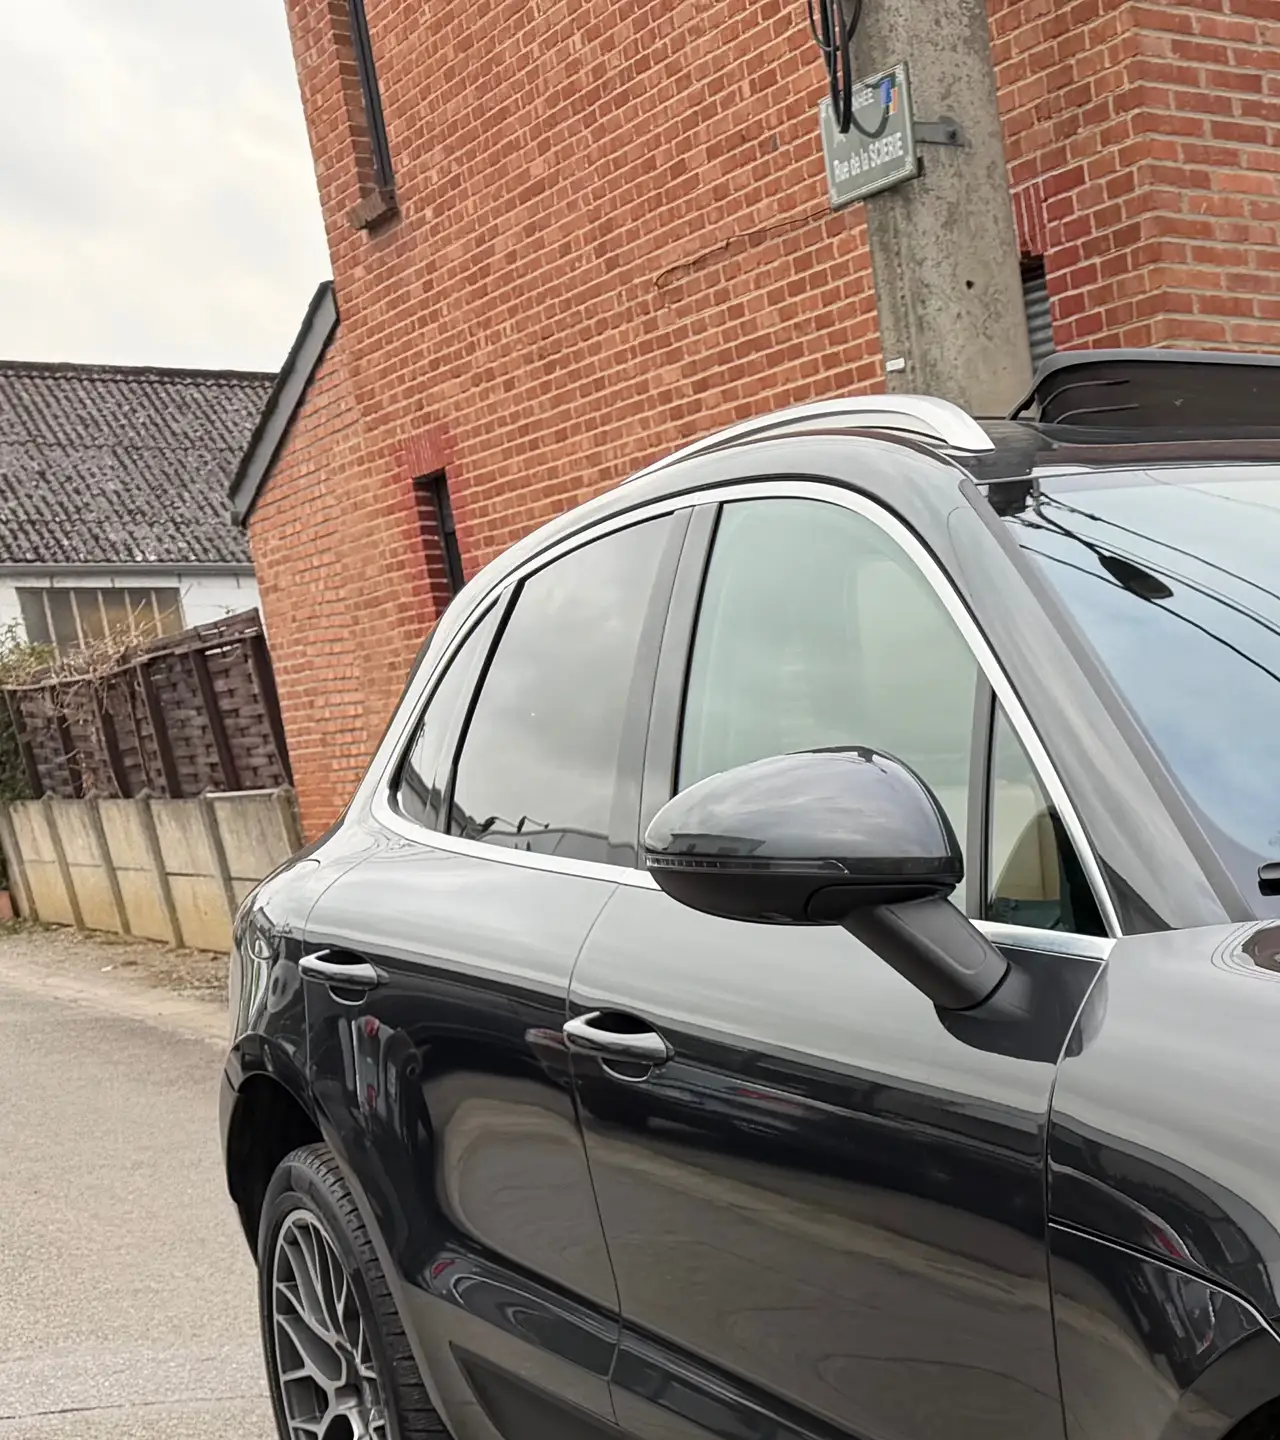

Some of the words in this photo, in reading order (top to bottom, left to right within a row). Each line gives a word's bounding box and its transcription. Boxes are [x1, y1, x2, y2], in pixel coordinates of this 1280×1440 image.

[832, 159, 850, 183] Rue
[850, 151, 861, 177] de
[860, 147, 870, 172] la
